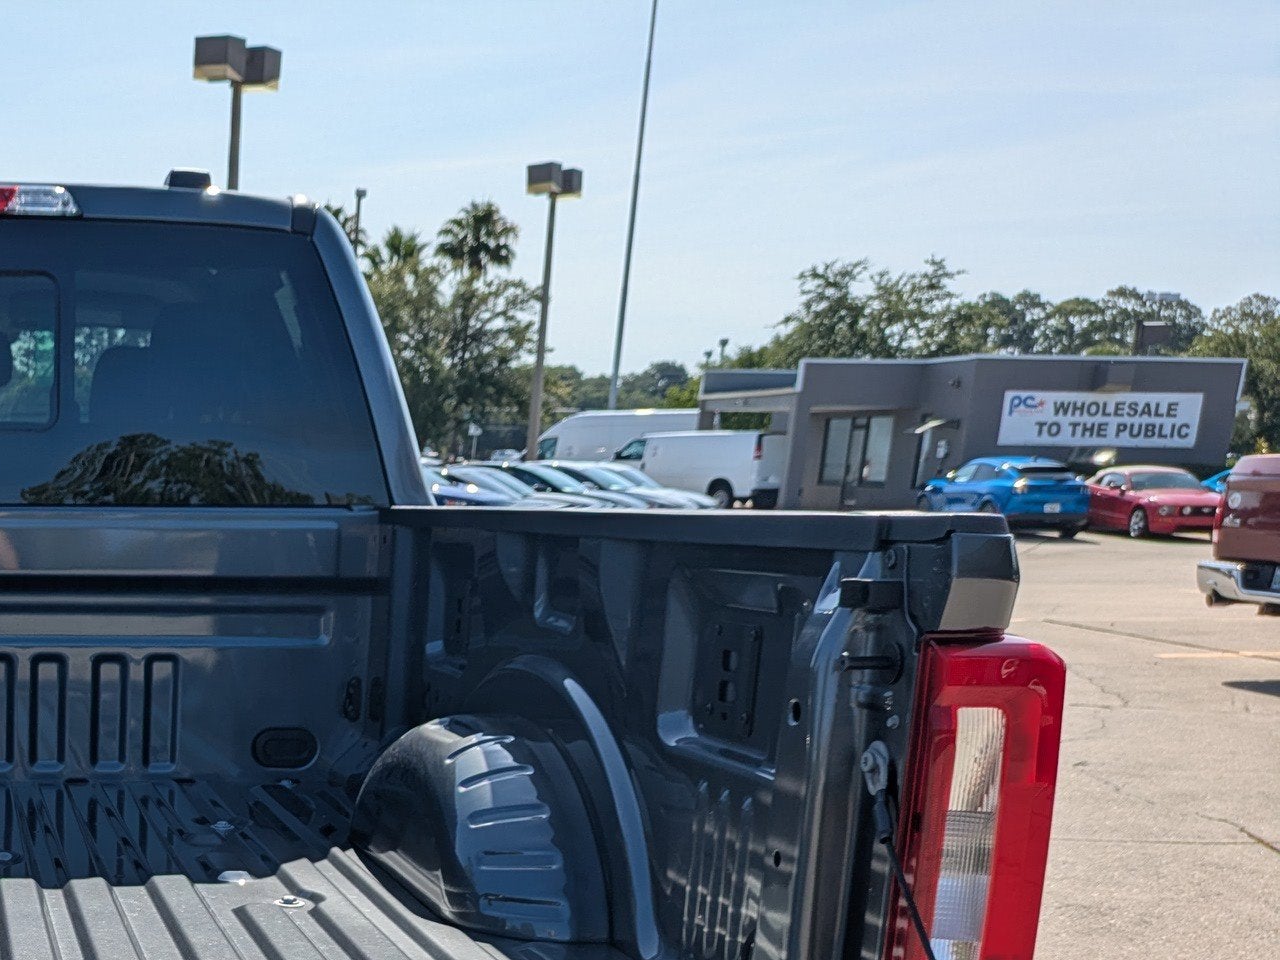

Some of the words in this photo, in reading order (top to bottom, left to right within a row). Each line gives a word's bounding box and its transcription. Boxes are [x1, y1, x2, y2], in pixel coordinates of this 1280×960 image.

[1053, 401, 1179, 418] WHOLESALE
[1035, 421, 1061, 438] TO
[1069, 422, 1107, 438] THE
[1115, 422, 1191, 439] PUBLIC
